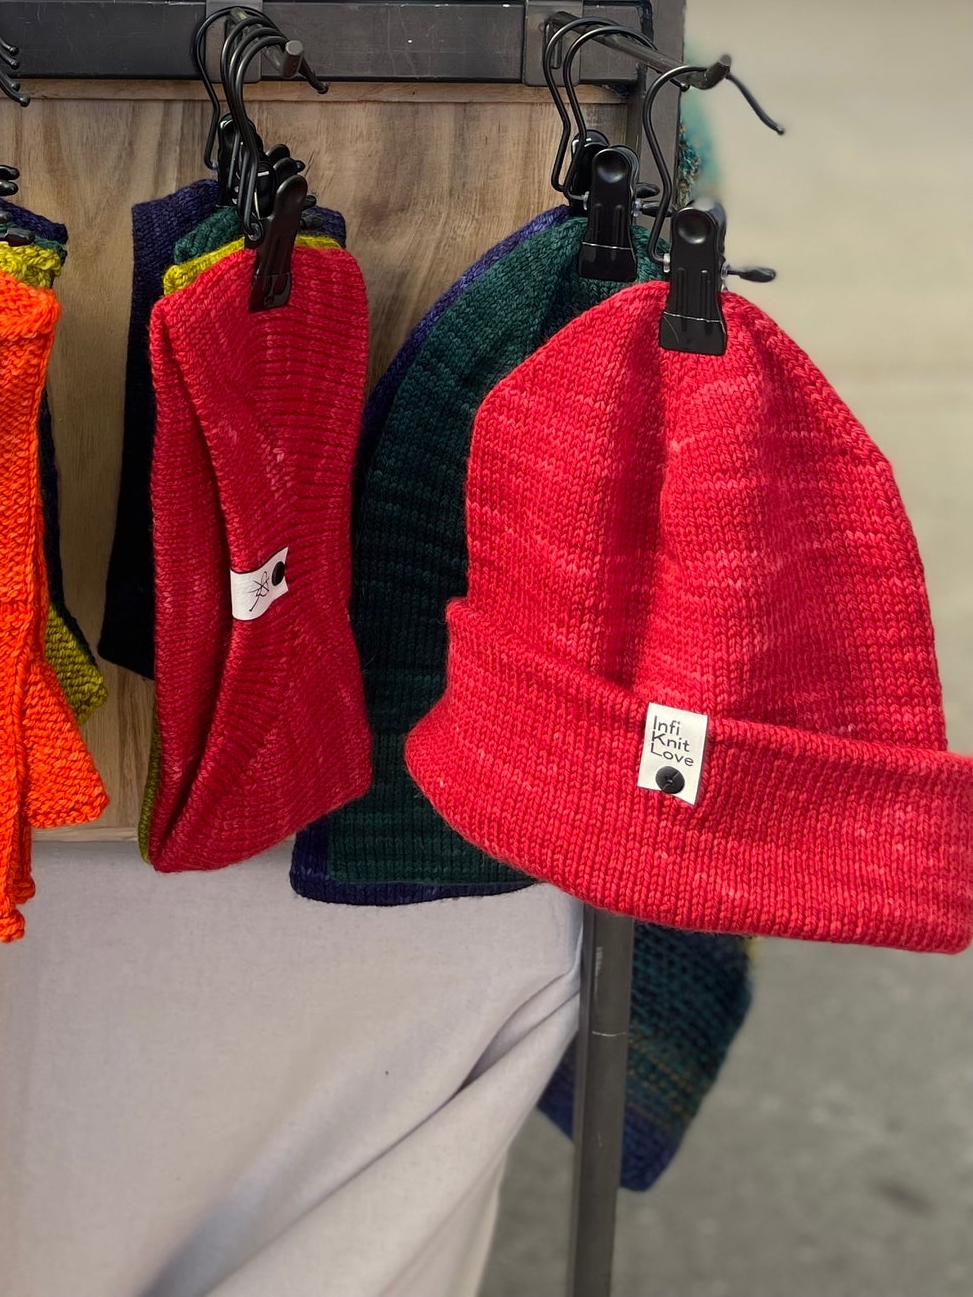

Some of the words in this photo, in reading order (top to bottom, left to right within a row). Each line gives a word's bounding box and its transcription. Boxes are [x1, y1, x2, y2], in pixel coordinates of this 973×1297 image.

[653, 715, 681, 736] Infi
[651, 730, 690, 752] Knit
[650, 742, 694, 767] Love
